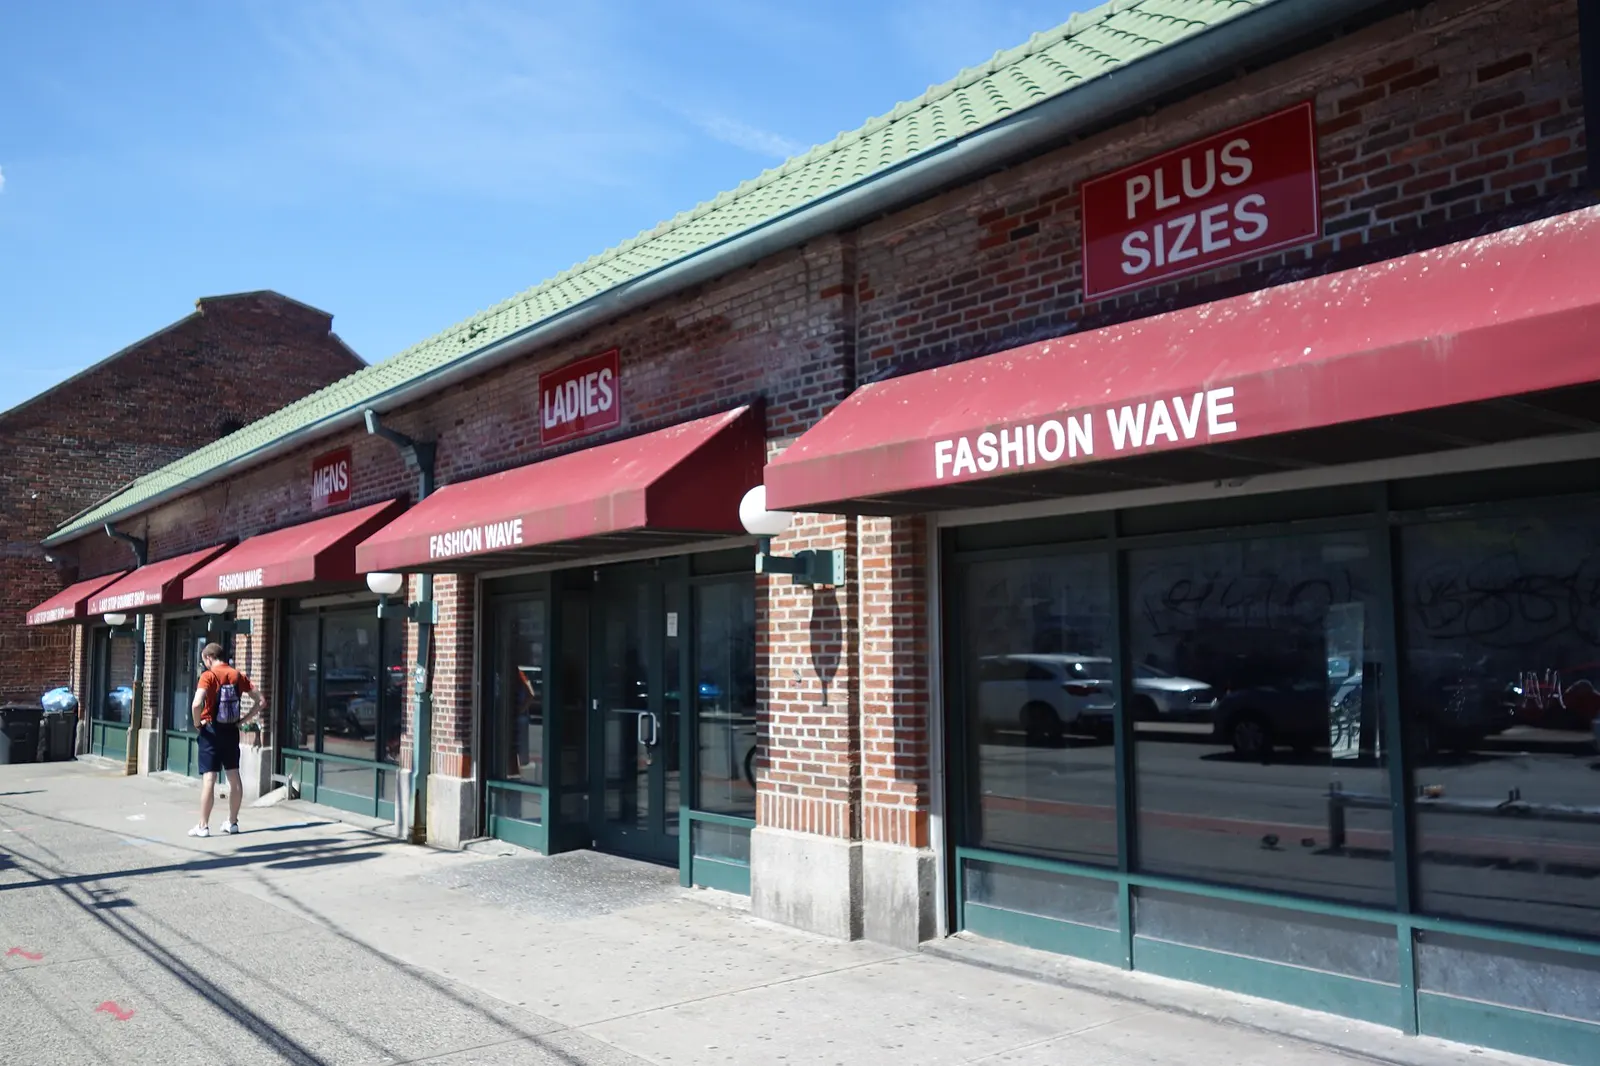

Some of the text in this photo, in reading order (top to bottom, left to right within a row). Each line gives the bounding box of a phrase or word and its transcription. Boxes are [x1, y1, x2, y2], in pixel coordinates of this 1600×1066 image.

[1126, 139, 1253, 220] PLUS
[1121, 194, 1268, 275] SIZES
[544, 368, 613, 429] LADIES
[934, 386, 1237, 479] FASHION WAVE
[313, 460, 348, 498] MENS
[430, 518, 523, 559] FASHION WAVE
[218, 568, 263, 592] FASHION WAVE
